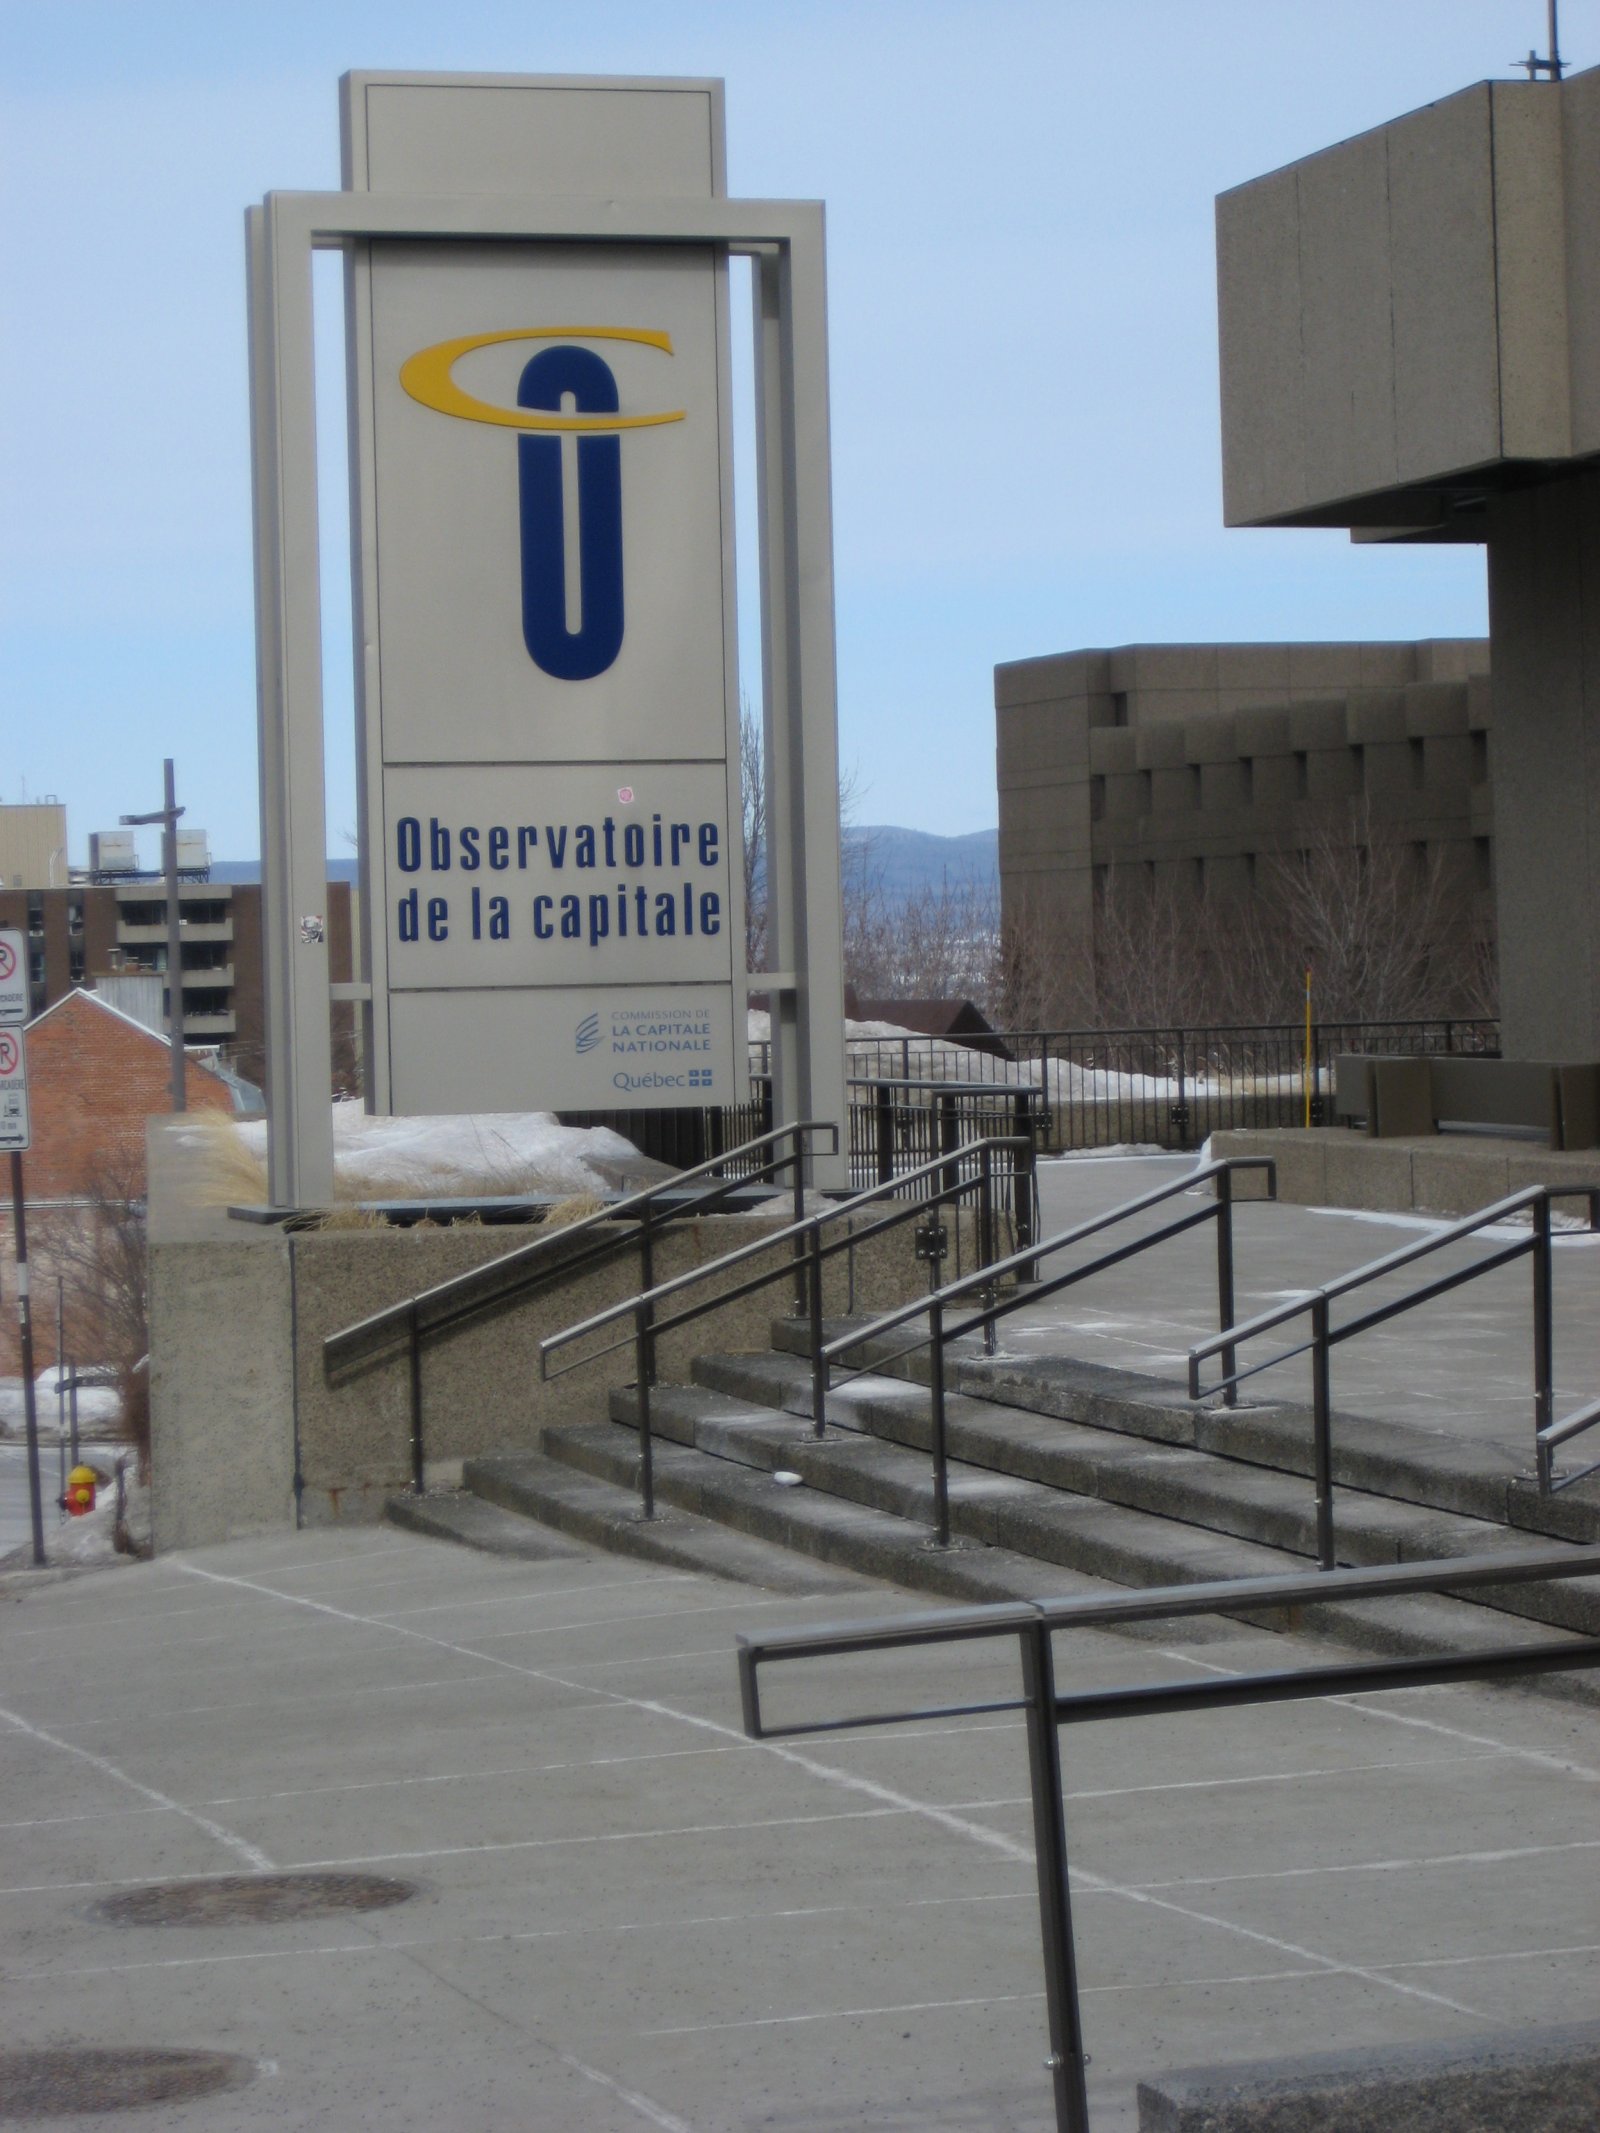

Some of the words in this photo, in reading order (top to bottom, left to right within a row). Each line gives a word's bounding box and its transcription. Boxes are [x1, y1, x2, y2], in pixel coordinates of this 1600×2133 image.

[397, 814, 719, 872] Observatoire
[398, 888, 448, 941] de
[472, 886, 510, 940] la
[533, 882, 720, 946] capitale
[611, 1010, 692, 1020] COMMISSION
[695, 1009, 710, 1018] DE
[612, 1025, 630, 1036] LA
[636, 1023, 711, 1036] CAPITALE
[612, 1039, 711, 1052] NATIONALE
[613, 1072, 686, 1092] Québec
